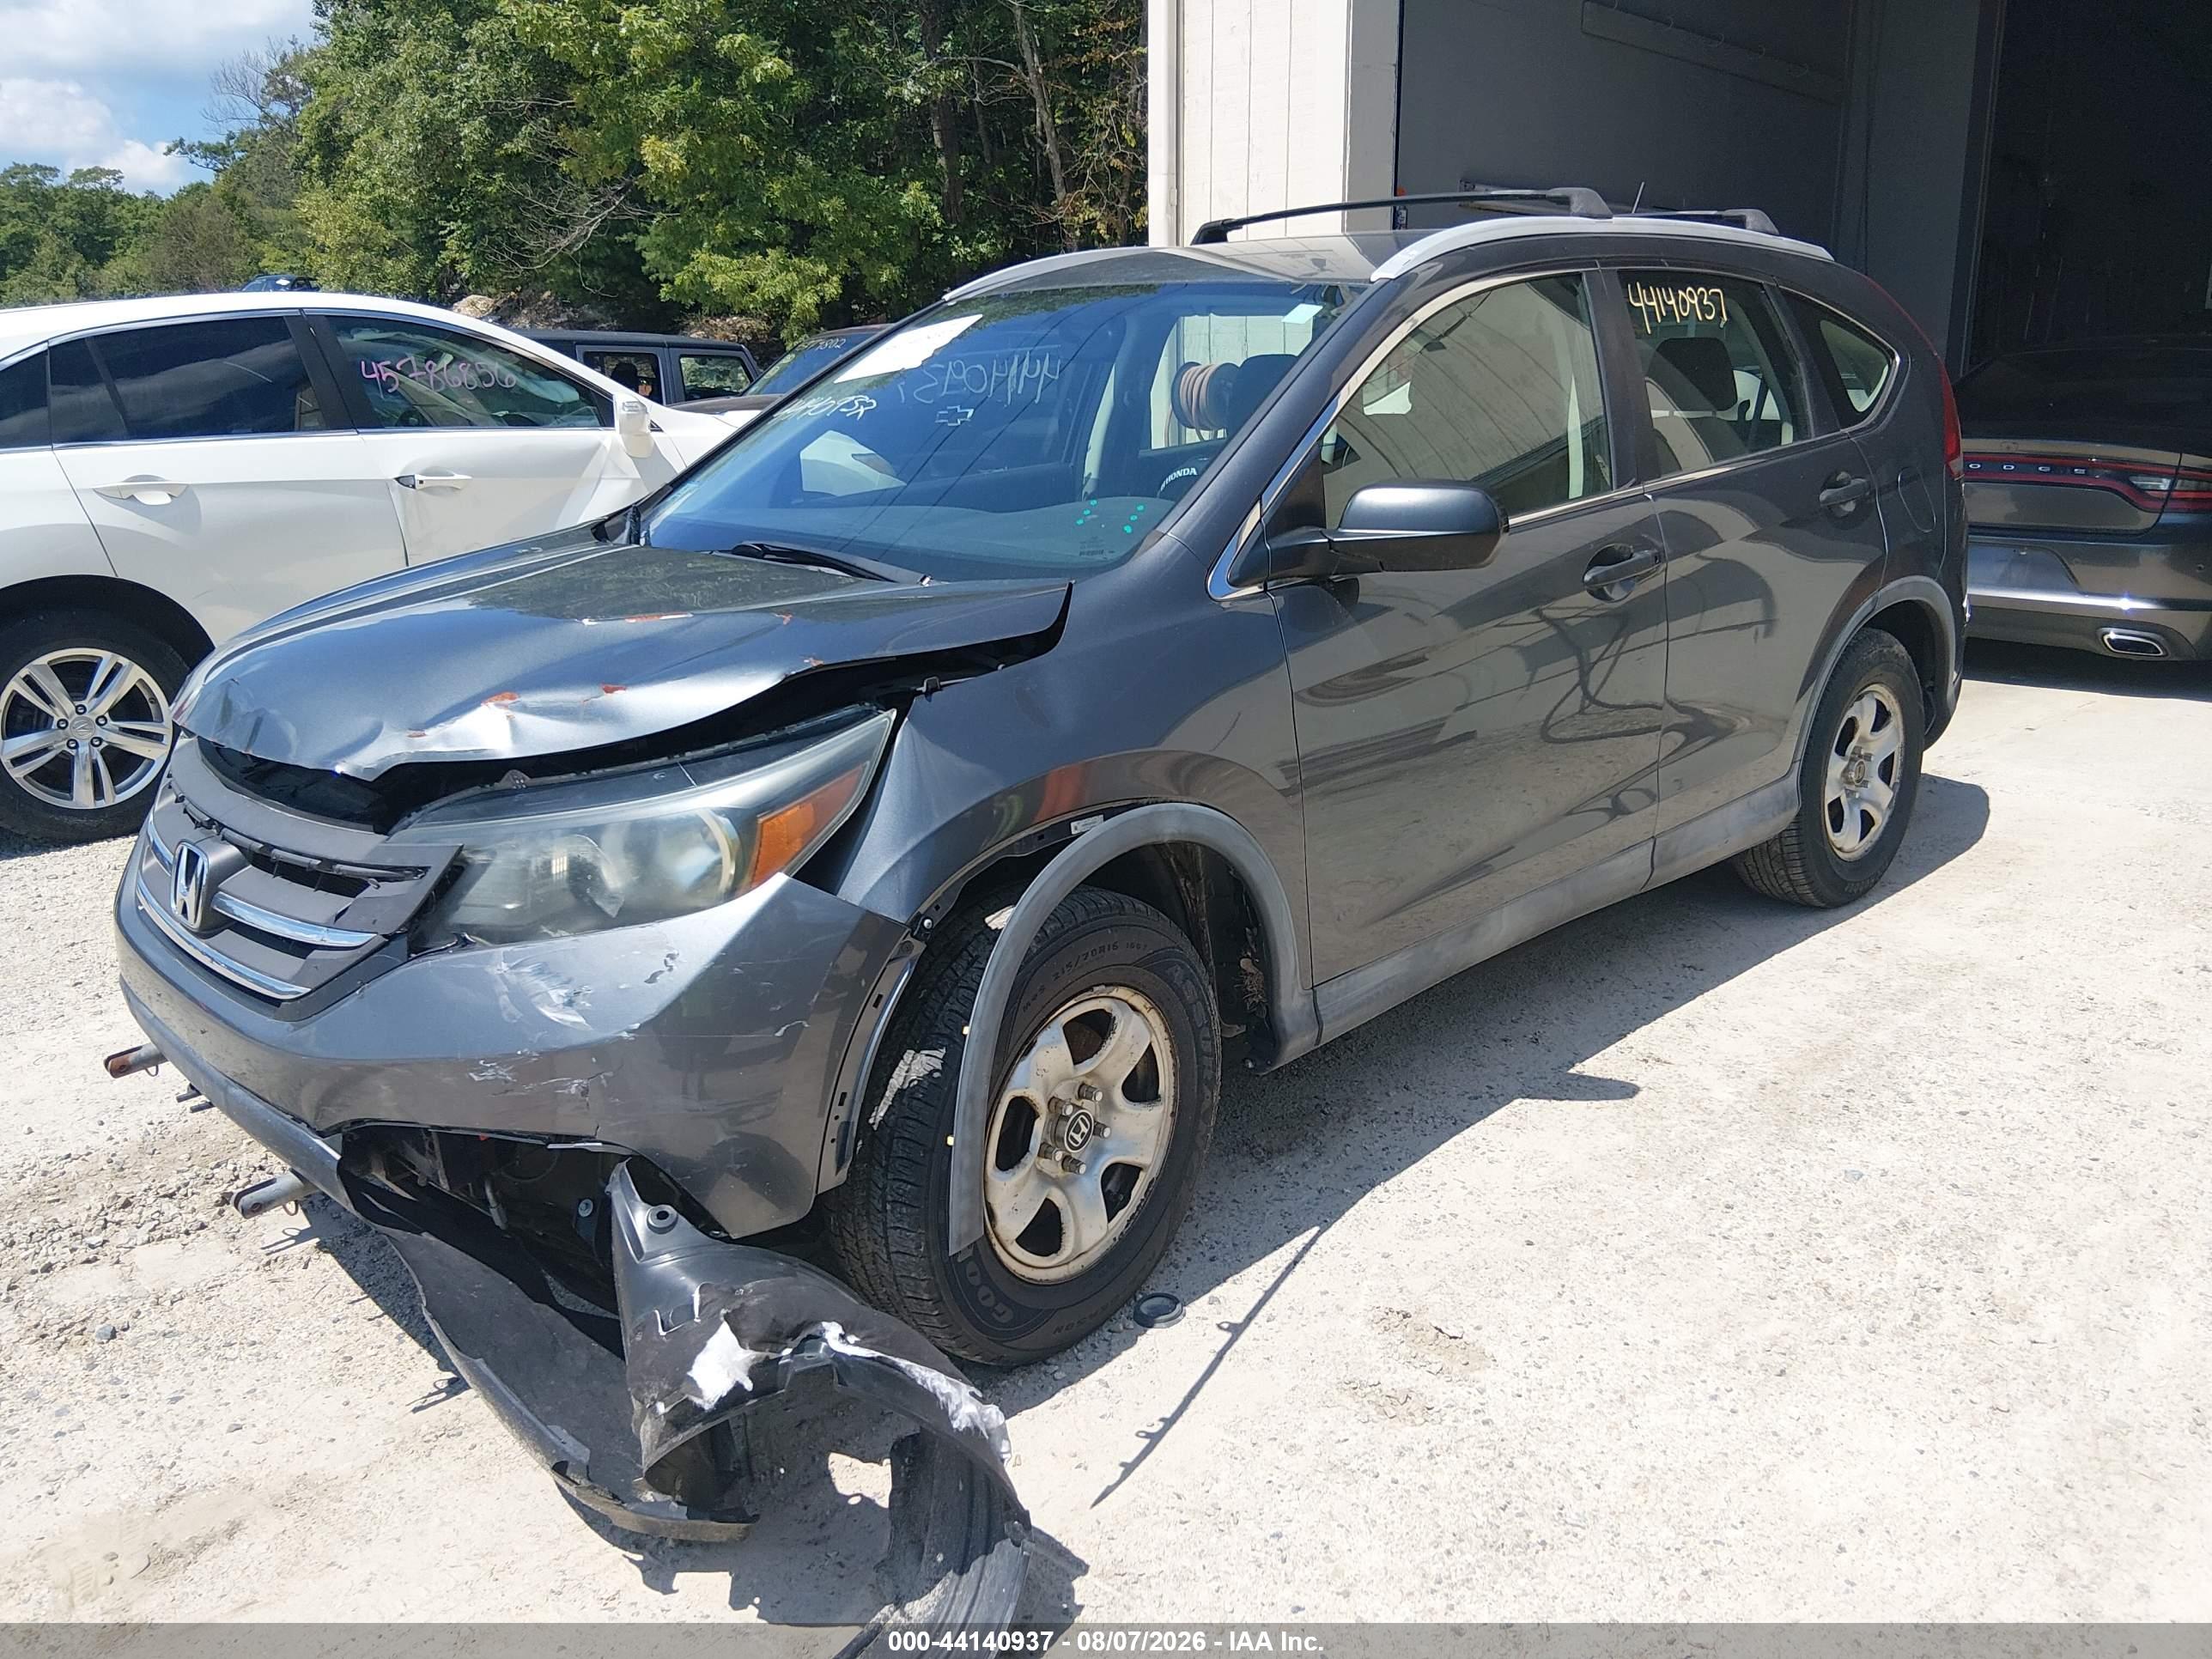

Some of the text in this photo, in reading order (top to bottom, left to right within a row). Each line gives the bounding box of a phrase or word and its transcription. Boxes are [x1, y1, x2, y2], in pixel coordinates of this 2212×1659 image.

[1627, 281, 1728, 335] 44140937
[361, 352, 516, 399] 45786856
[1165, 467, 1198, 485] HONDA
[1968, 463, 2086, 475] ODGE
